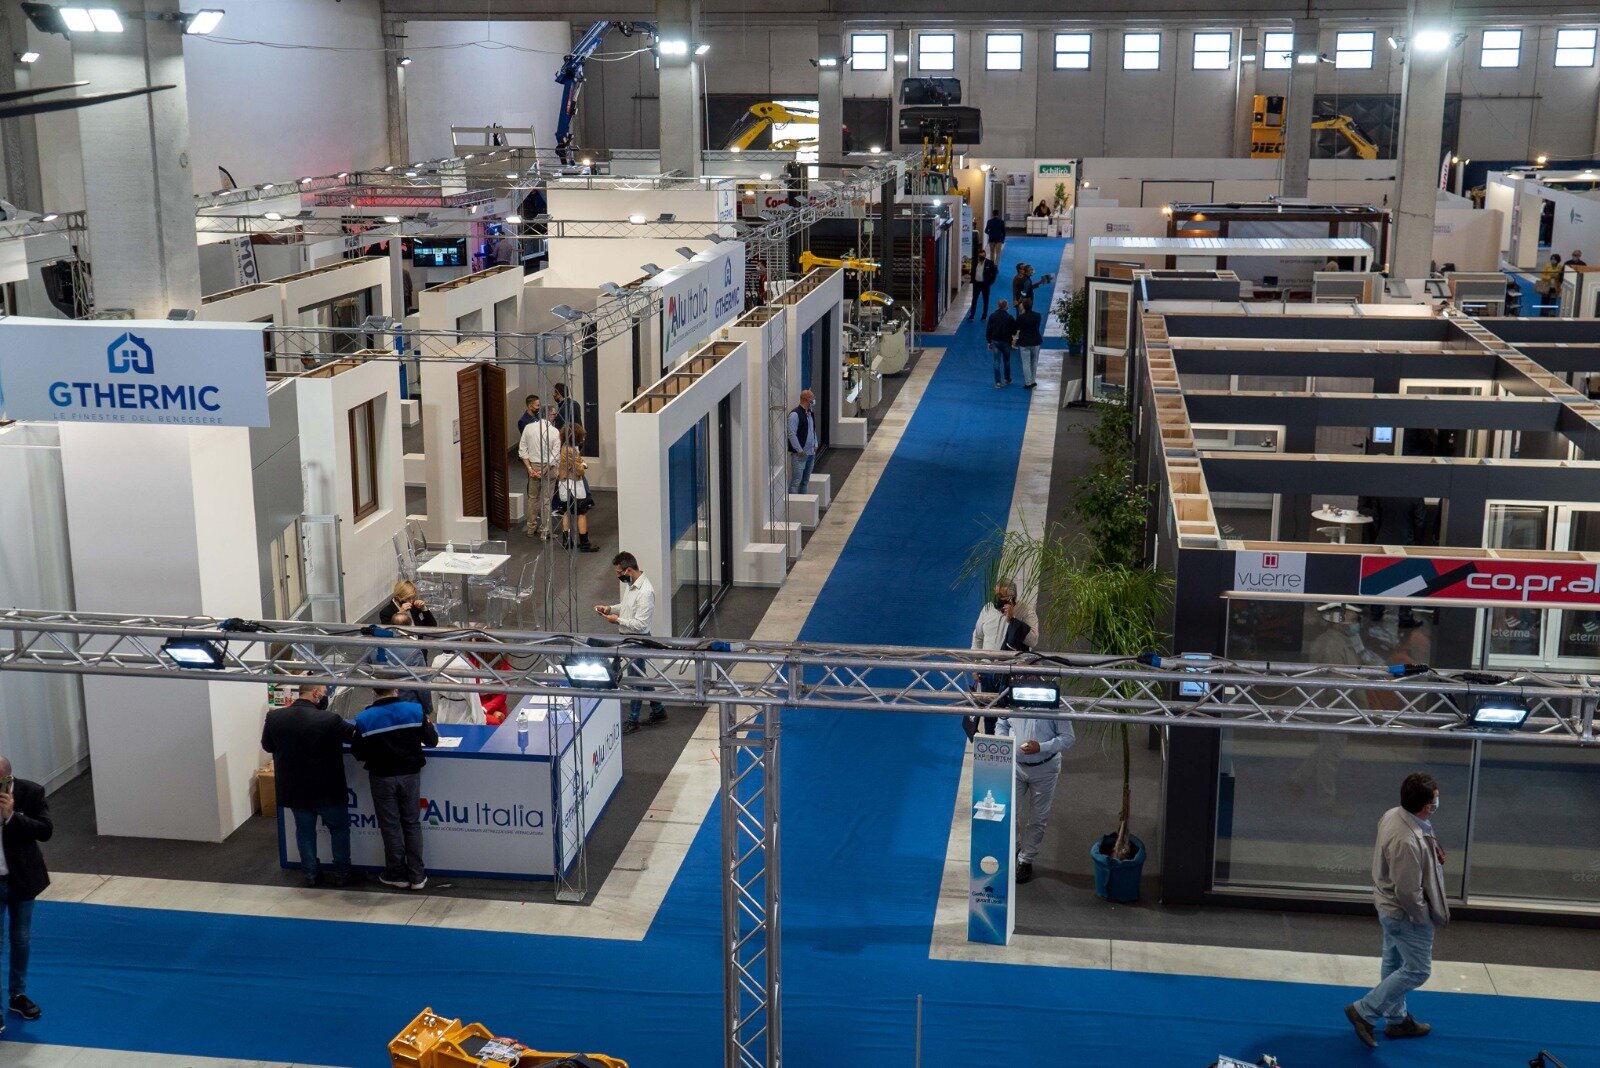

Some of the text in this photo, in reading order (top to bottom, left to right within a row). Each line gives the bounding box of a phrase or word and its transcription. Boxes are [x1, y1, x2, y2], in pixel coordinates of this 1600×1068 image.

[671, 293, 687, 334] Alu
[688, 282, 708, 323] Italia
[715, 287, 740, 319] GTHERMIC
[48, 381, 221, 412] GTHERMIC
[72, 413, 126, 422] FINESTRE
[132, 414, 152, 422] DEL
[158, 415, 223, 424] BENESSERE
[1238, 572, 1301, 588] vuerre
[1491, 628, 1531, 639] eterma
[1569, 631, 1600, 642] eterm
[422, 799, 544, 828] Alu Italia
